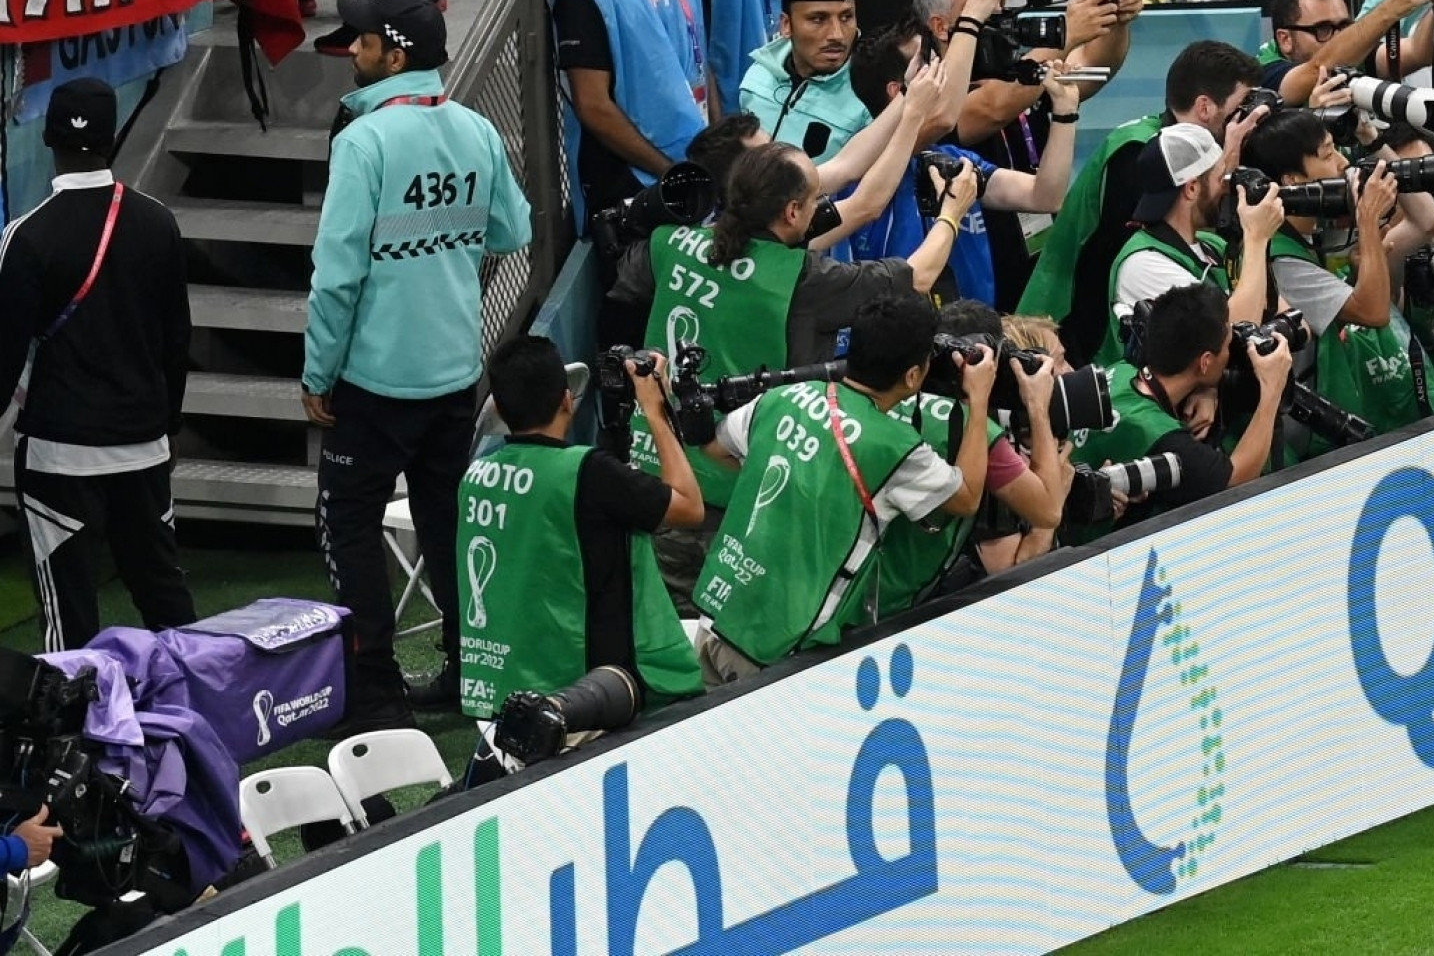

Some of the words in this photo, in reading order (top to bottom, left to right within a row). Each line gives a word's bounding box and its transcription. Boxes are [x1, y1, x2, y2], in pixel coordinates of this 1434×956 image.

[402, 171, 477, 211] 4361
[668, 225, 756, 281] PHOO
[668, 263, 721, 309] 572
[1414, 369, 1426, 402] SONY
[780, 381, 862, 445] PHOTO
[776, 415, 820, 463] 039
[464, 459, 534, 495] PHOTO
[465, 496, 508, 530] 301
[742, 557, 767, 576] CUP
[492, 643, 511, 656] CUP
[273, 702, 293, 716] FIFA
[290, 691, 320, 710] WORLD
